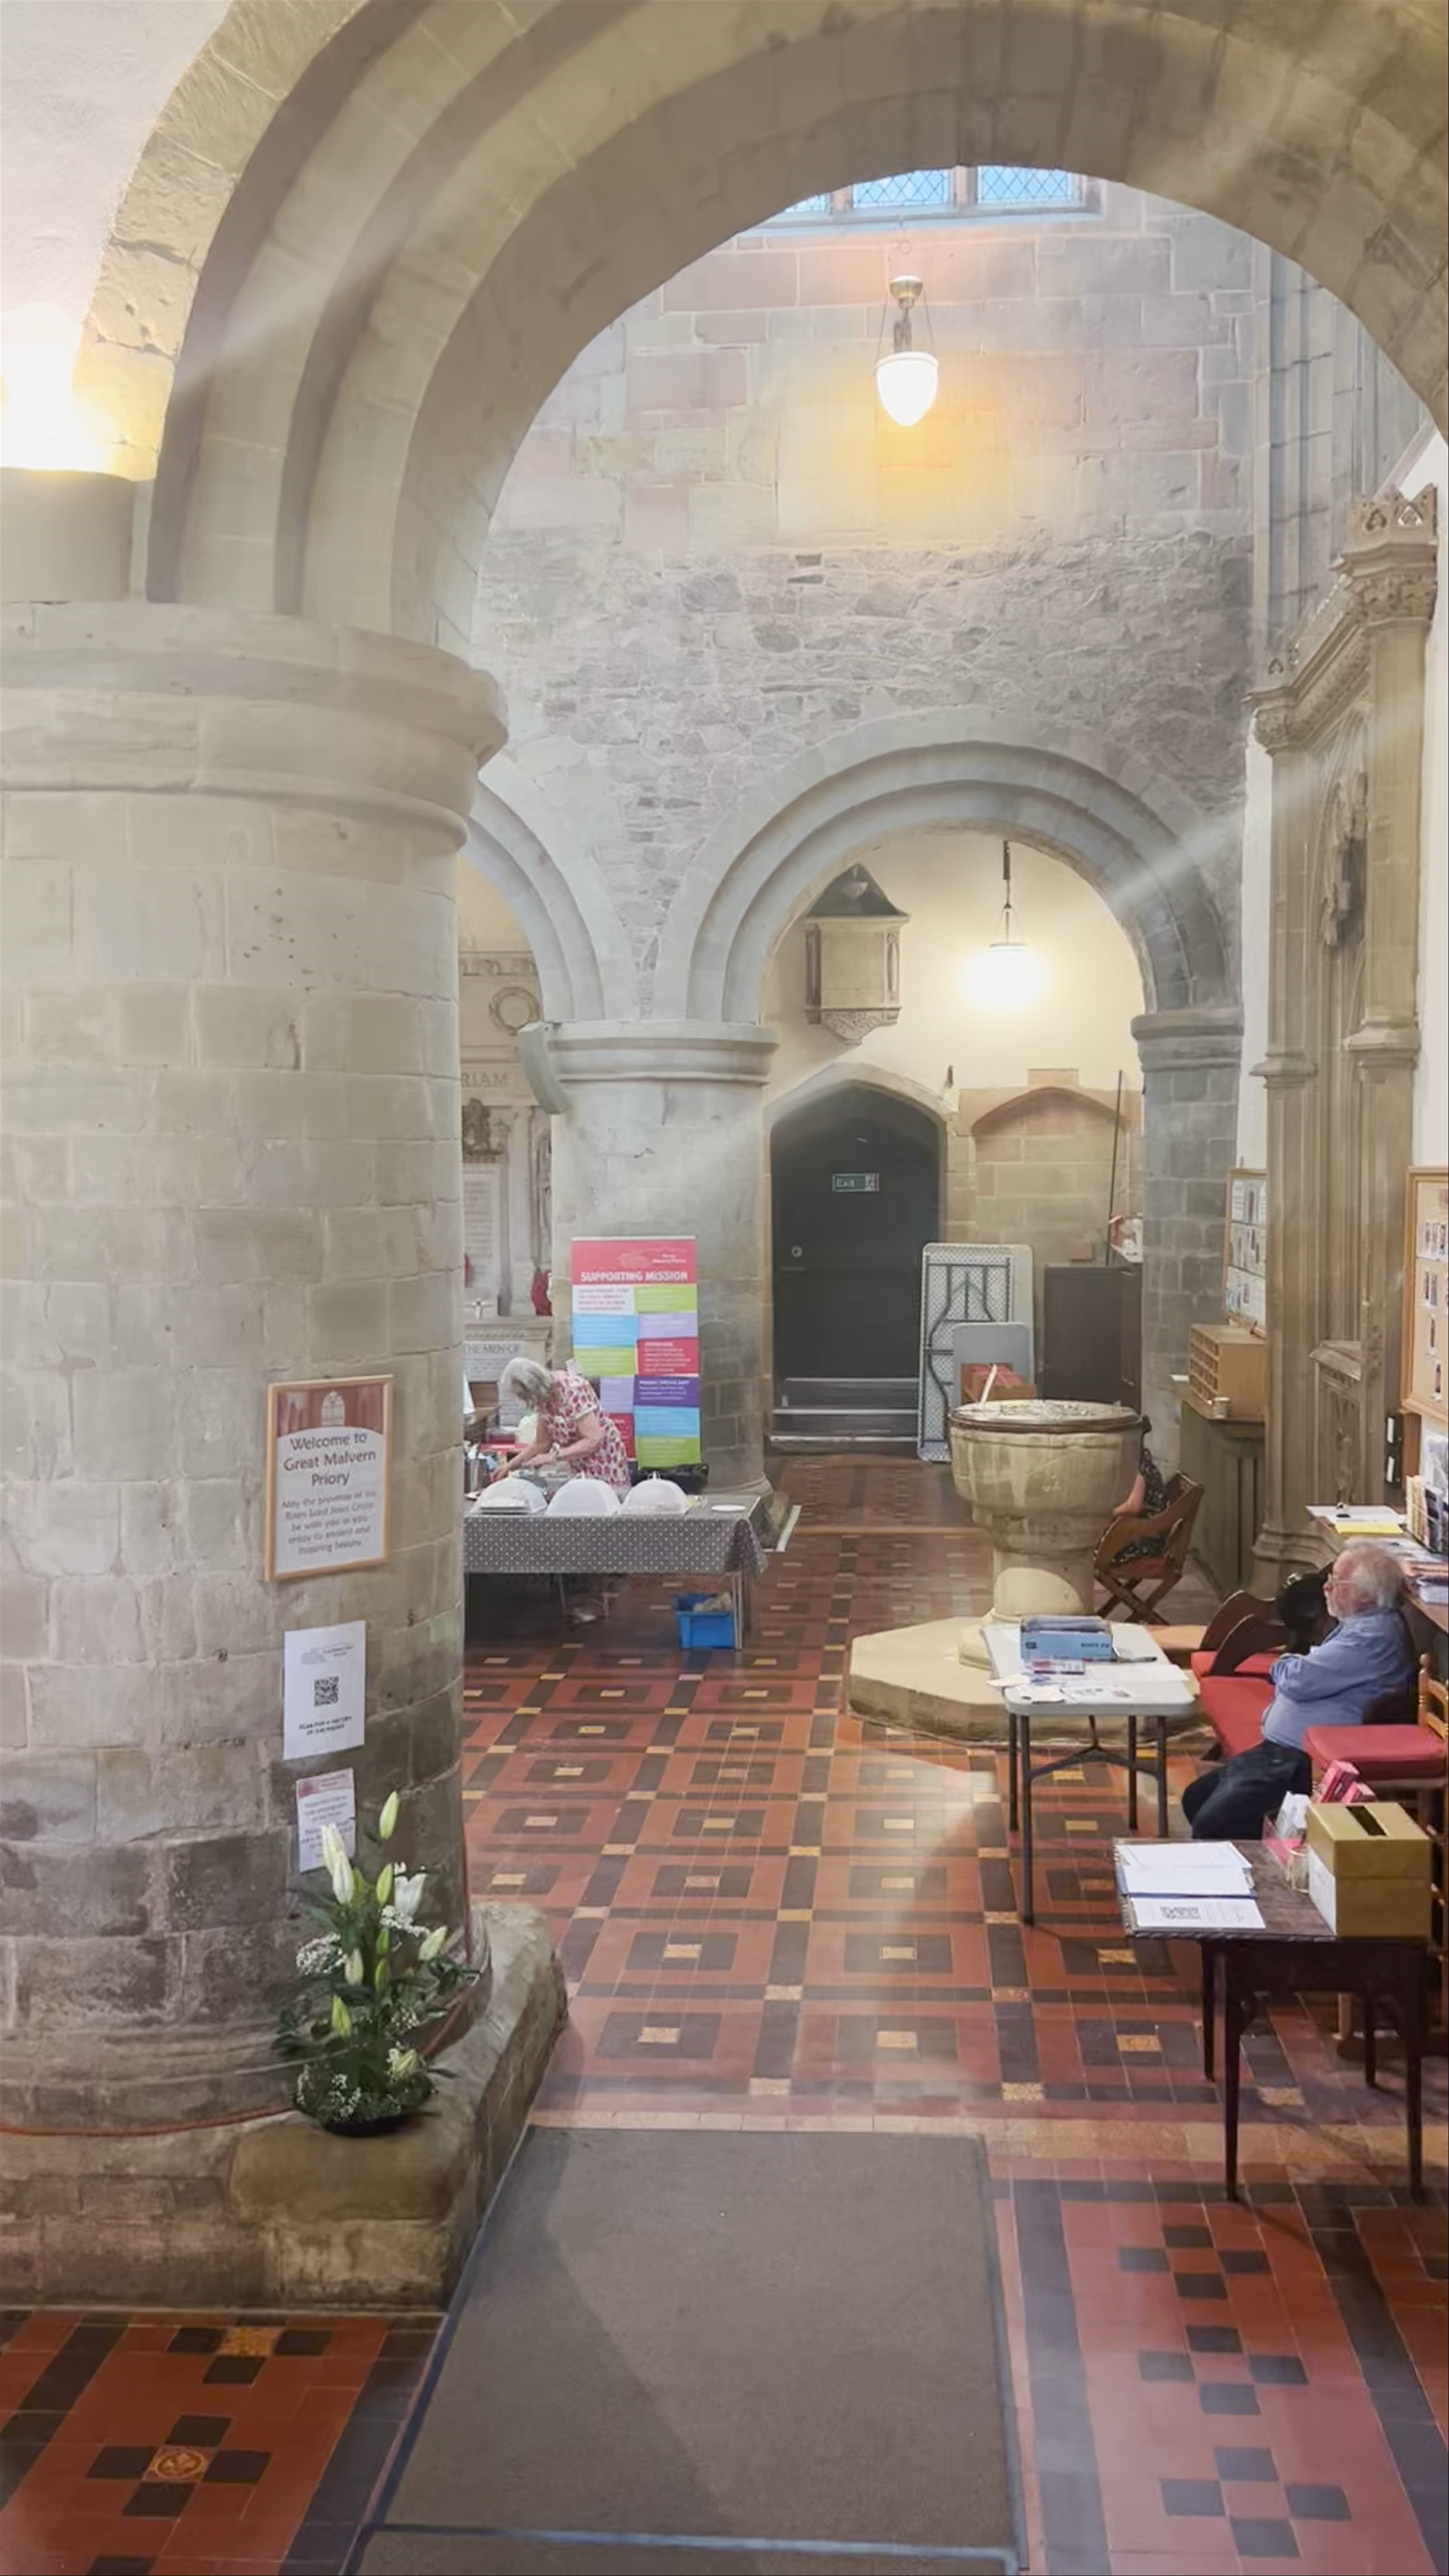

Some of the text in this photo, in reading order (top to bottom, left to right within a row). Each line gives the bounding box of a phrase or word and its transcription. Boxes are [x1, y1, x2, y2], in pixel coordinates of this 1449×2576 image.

[580, 1271, 688, 1282] SUPPORTING MISSION
[290, 1433, 367, 1450] Welcome to
[283, 1451, 376, 1471] Great Malvern
[312, 1473, 350, 1486] Priory
